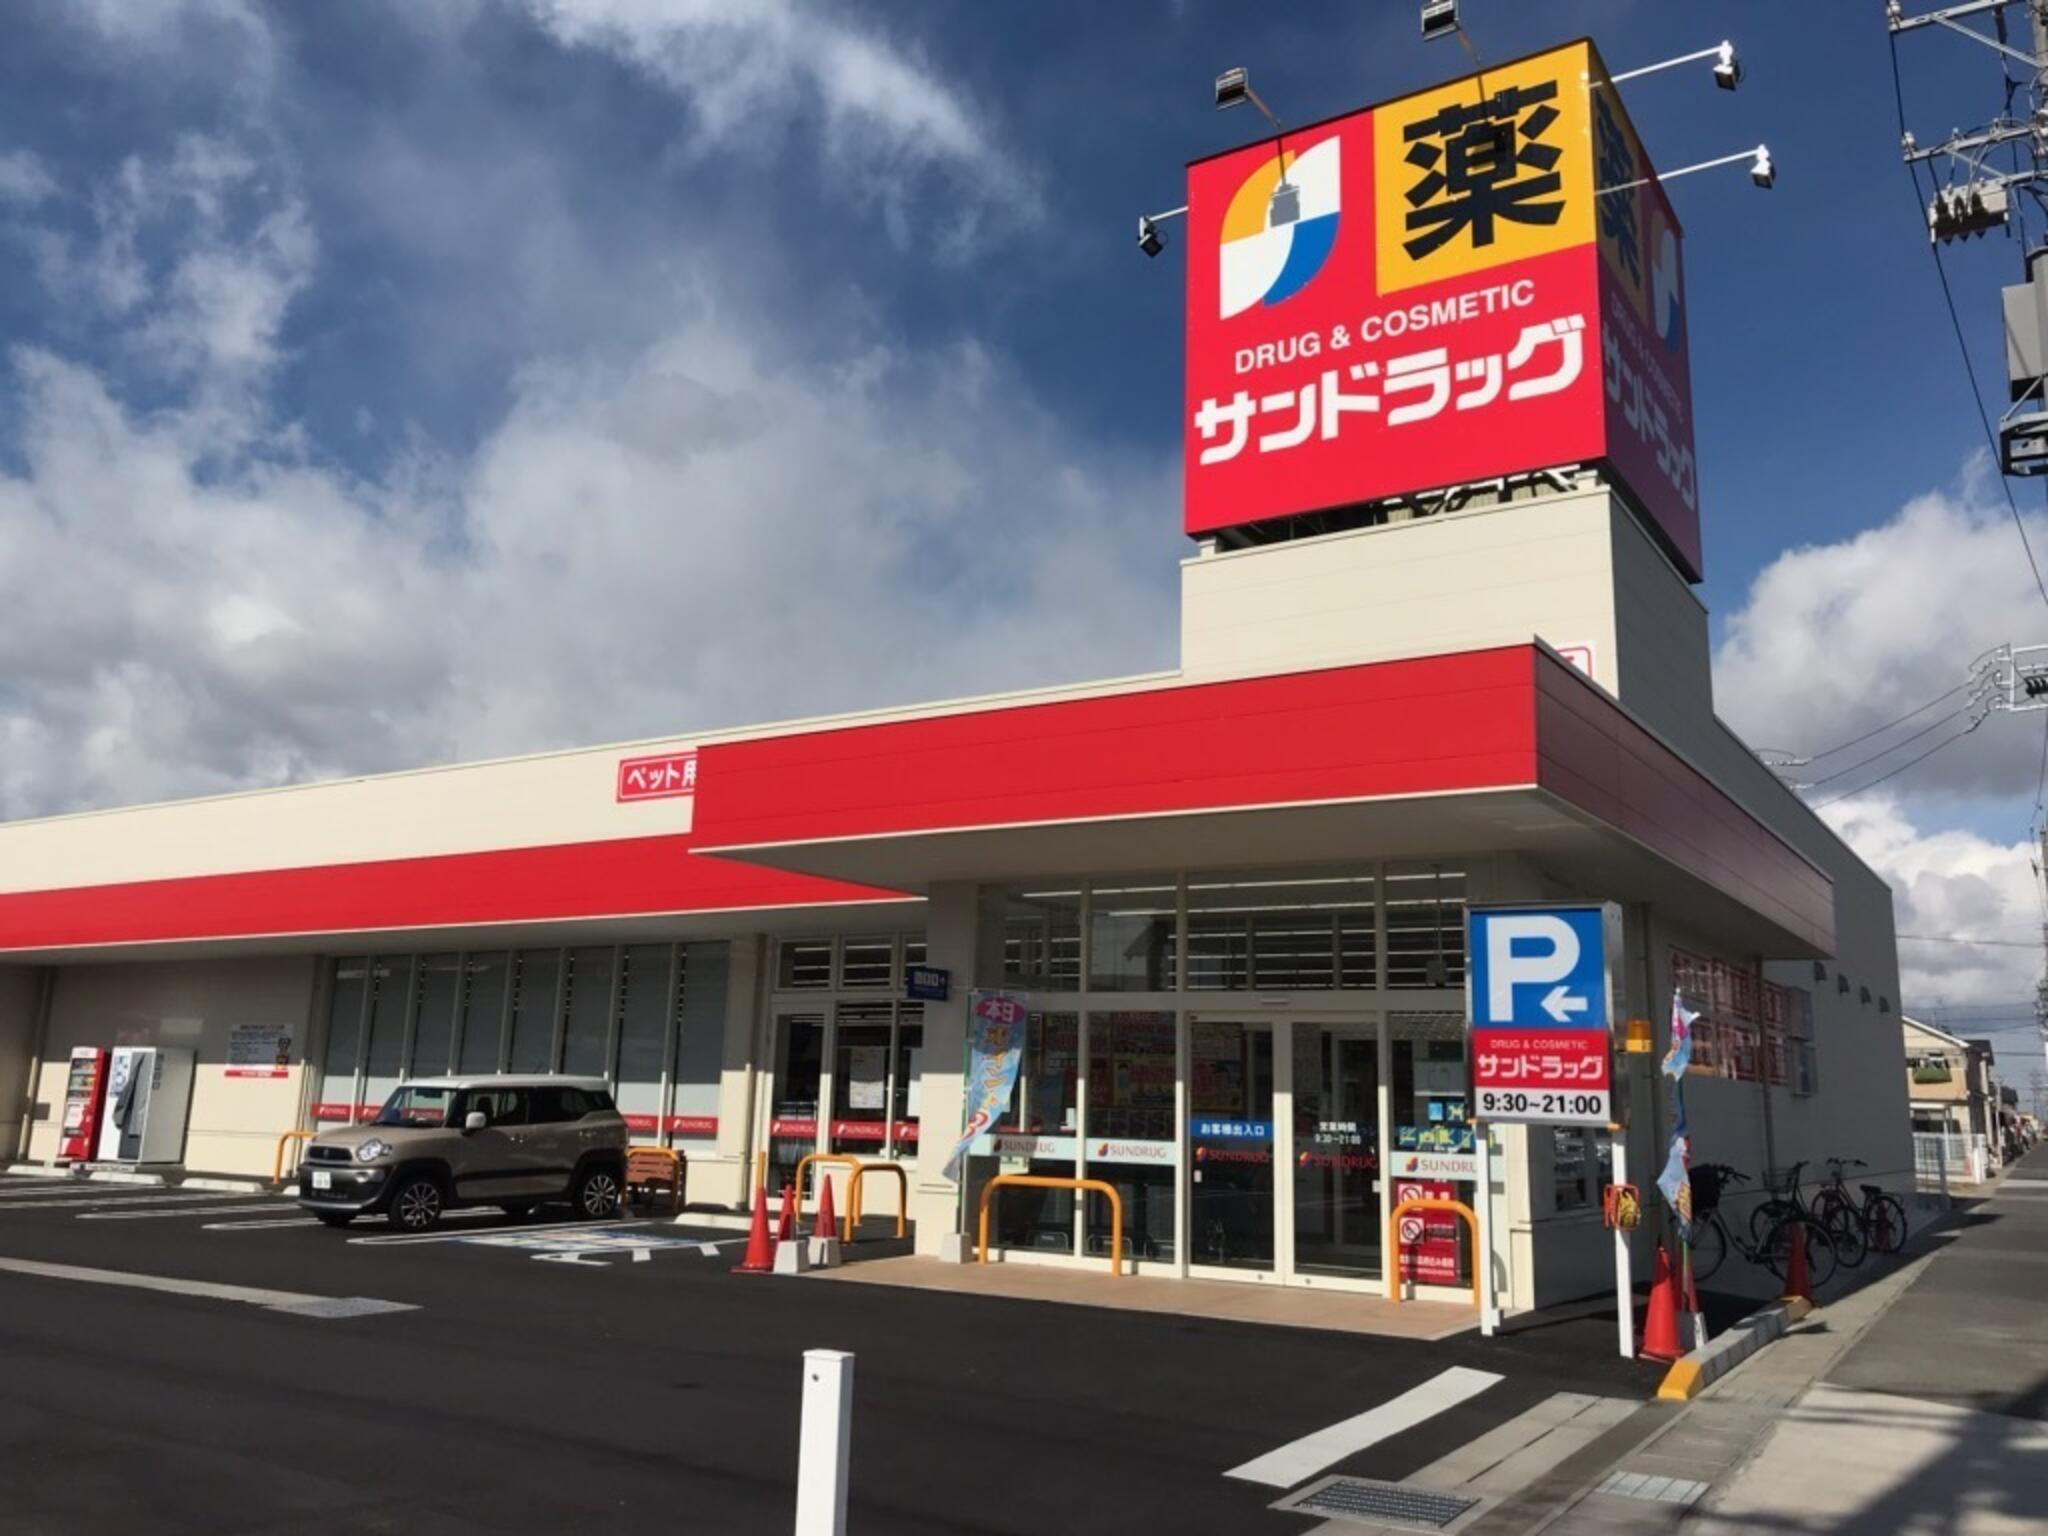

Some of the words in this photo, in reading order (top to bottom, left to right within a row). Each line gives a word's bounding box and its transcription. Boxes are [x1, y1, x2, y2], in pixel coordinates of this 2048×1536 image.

[1403, 79, 1565, 262] 薬
[1235, 331, 1321, 375] DRUG
[1330, 325, 1351, 350] &
[1360, 279, 1536, 343] COSMETIC
[1194, 313, 1587, 466] サンドラッグ
[1486, 915, 1581, 1023] P
[1478, 1053, 1604, 1081] サンドラッグ
[1490, 1039, 1521, 1050] DRUG
[1532, 1039, 1589, 1051] COSMETIC
[1003, 1141, 1056, 1154] SUNDRUG
[1110, 1145, 1167, 1159] SUNDRUG
